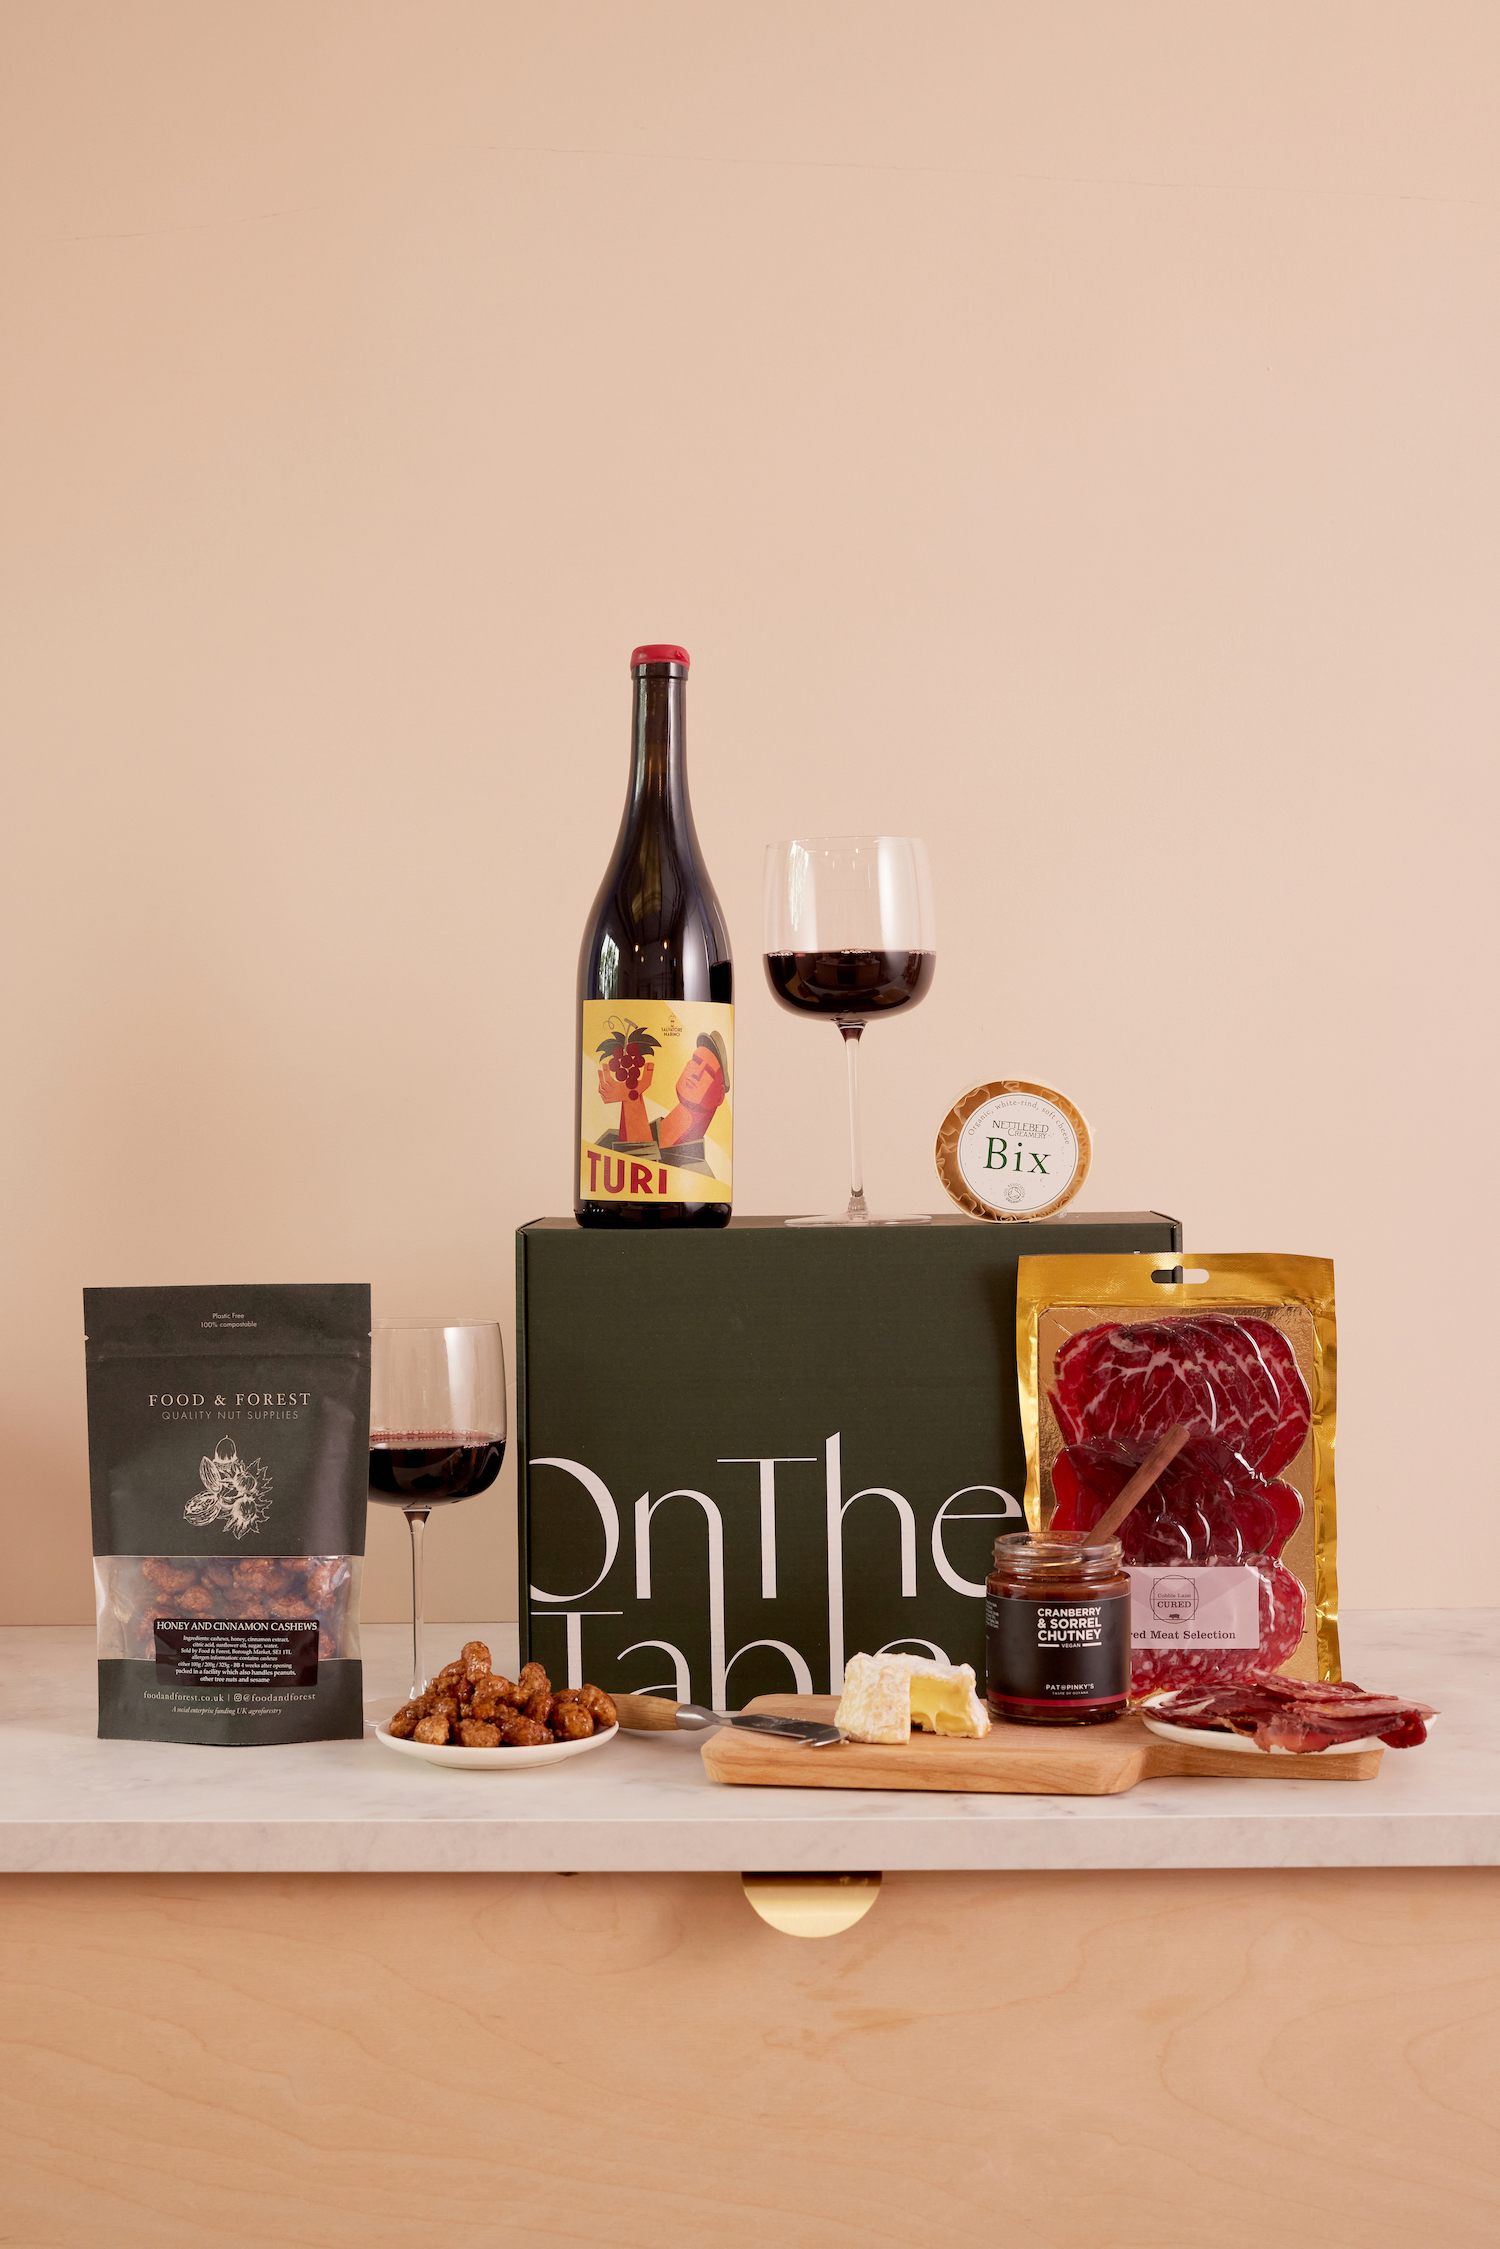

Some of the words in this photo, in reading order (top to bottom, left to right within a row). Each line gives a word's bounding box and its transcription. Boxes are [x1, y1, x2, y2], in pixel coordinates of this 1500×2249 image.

[968, 1109, 994, 1136] Organic,
[995, 1100, 1039, 1110] white-rind,
[1042, 1107, 1056, 1120] soft
[1056, 1120, 1070, 1145] cheese
[992, 1120, 1049, 1132] NETTLEBED
[1008, 1128, 1047, 1139] CREAMERY
[983, 1136, 1052, 1175] Bix
[587, 1150, 668, 1194] TURI
[148, 1394, 205, 1406] FOOD
[214, 1394, 227, 1406] &
[236, 1393, 311, 1406] FOREST
[162, 1411, 212, 1420] QUALITY
[218, 1411, 241, 1420] NUT
[247, 1410, 299, 1420] SUPPLIES
[1037, 1607, 1102, 1617] CRANBERRY
[157, 1622, 190, 1630] HONEY
[191, 1622, 212, 1630] AND
[213, 1622, 268, 1631] CINNAMON
[270, 1622, 318, 1631] CASHEWS
[1037, 1618, 1046, 1628] &
[1050, 1617, 1102, 1629] SORREL
[1037, 1629, 1102, 1641] CHUTNEY
[1151, 1630, 1179, 1639] Meat
[1183, 1630, 1236, 1639] Selection
[143, 1691, 224, 1702] foodandforest.co.uk
[214, 1708, 235, 1716] funding
[248, 1708, 282, 1716] agroforestry
